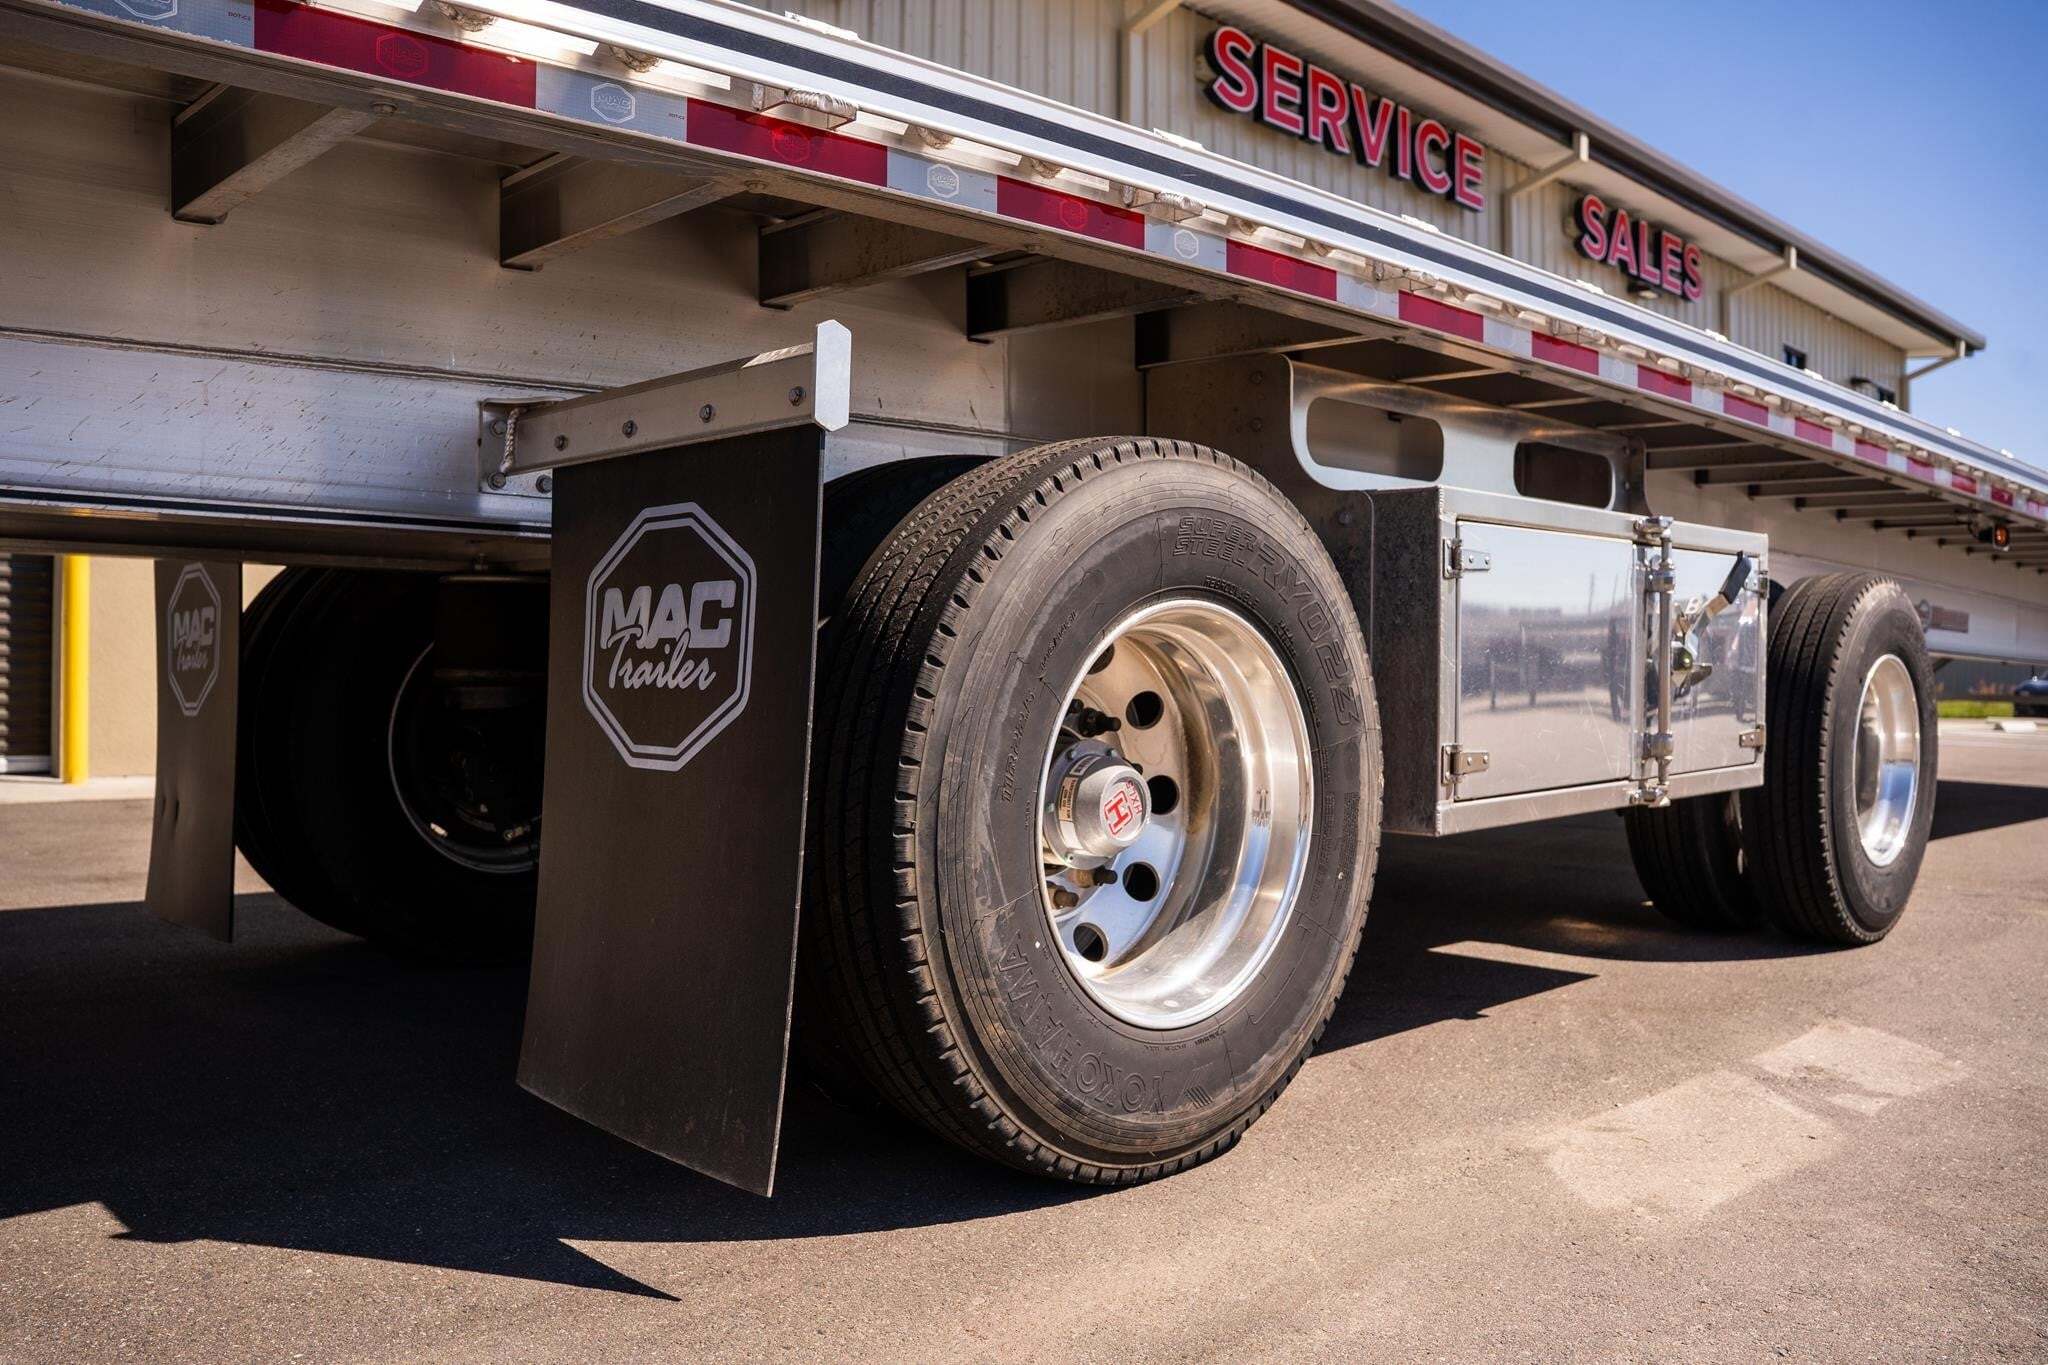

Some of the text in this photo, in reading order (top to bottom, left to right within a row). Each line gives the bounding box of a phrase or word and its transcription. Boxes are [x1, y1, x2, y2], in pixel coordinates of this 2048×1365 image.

[1209, 26, 1486, 212] SERVICE
[1577, 194, 1703, 301] SALES
[1172, 535, 1246, 568] STEEL
[1178, 515, 1257, 552] SUPER
[173, 606, 215, 648] MAC
[600, 580, 736, 650] MAC
[607, 627, 716, 690] Trailer
[998, 929, 1178, 1115] YOKOHAMA
